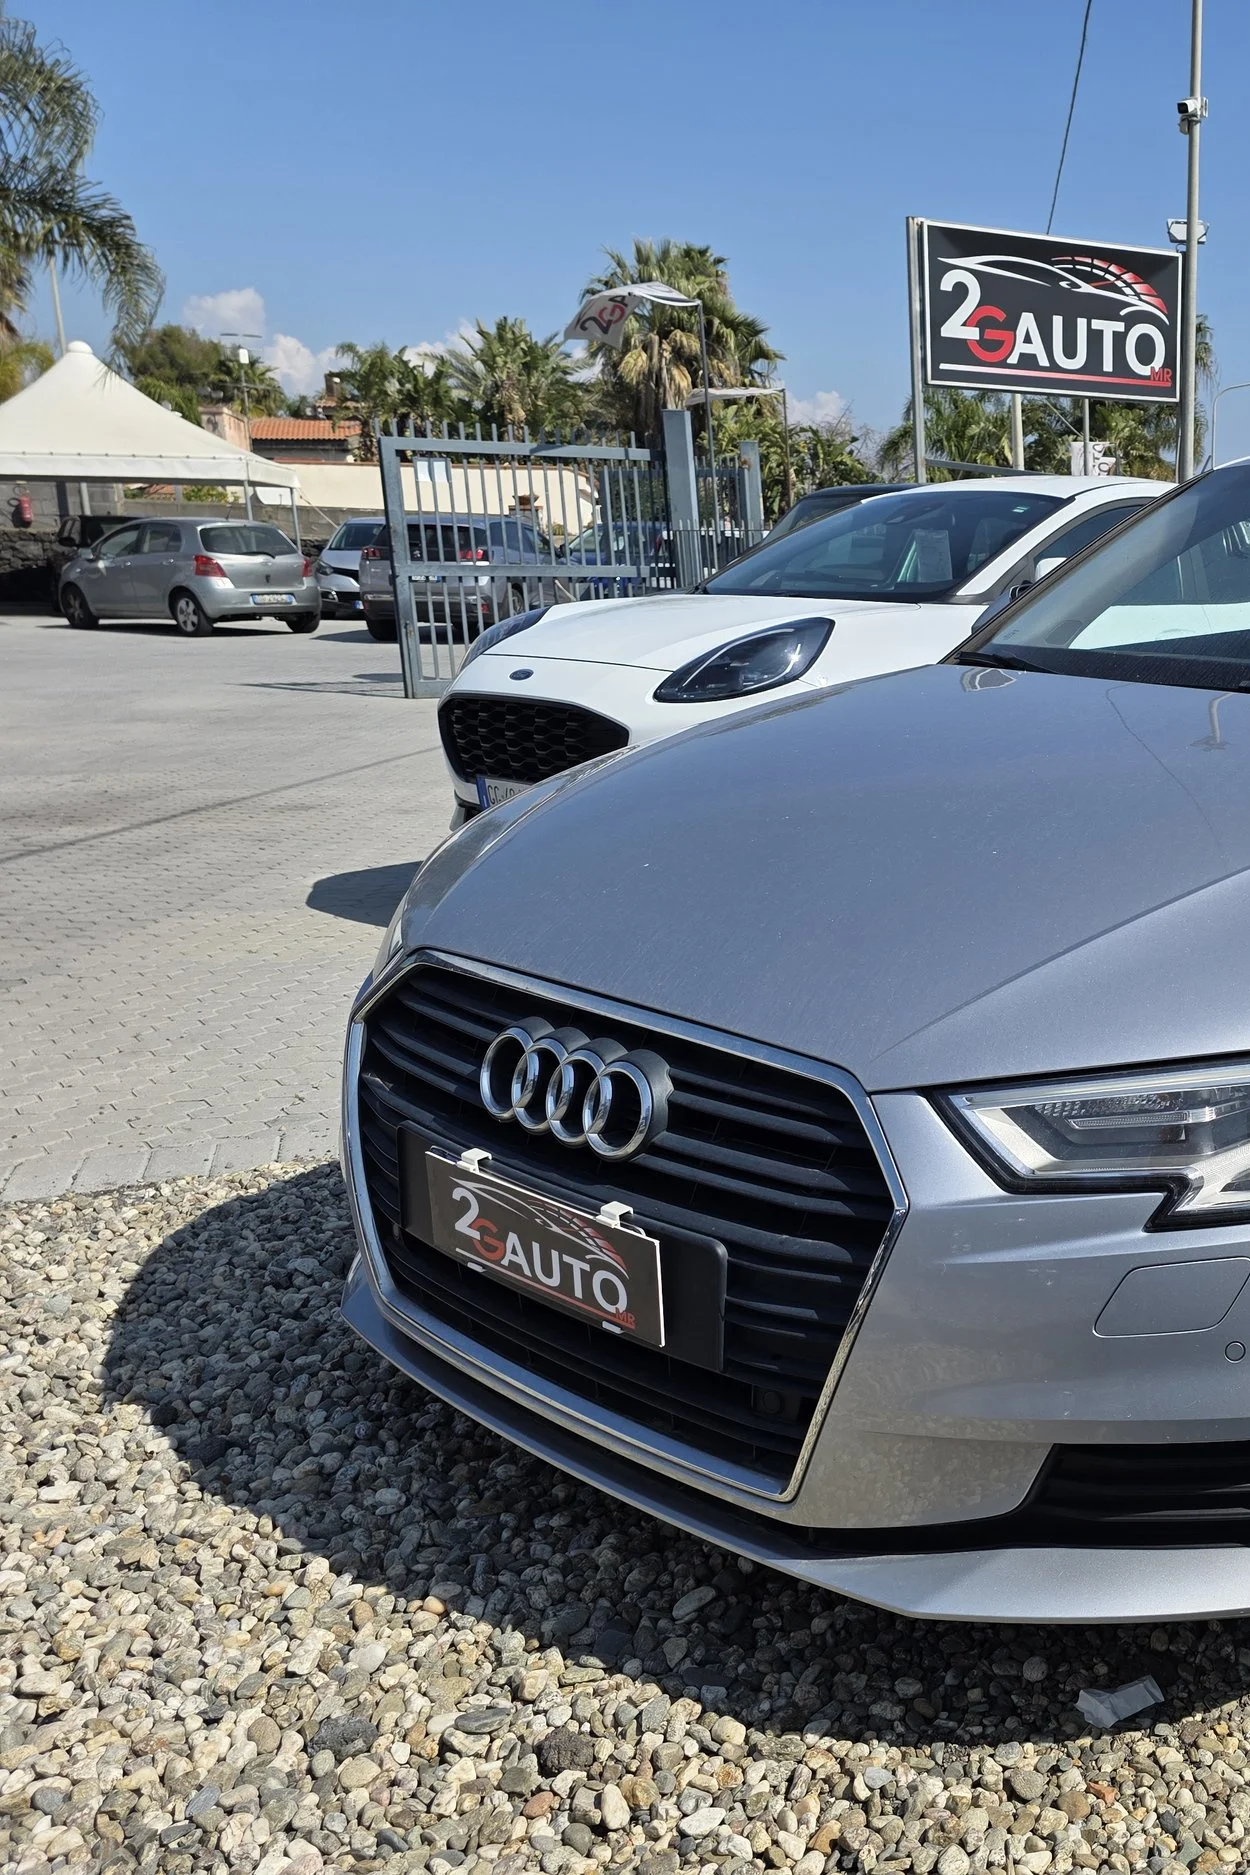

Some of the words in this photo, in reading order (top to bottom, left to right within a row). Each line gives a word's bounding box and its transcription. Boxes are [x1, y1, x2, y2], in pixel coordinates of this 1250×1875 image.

[940, 269, 1166, 376] 2GAUTO
[1150, 366, 1172, 383] MR
[452, 1187, 628, 1313] 2GAUTO
[615, 1306, 636, 1326] MR
